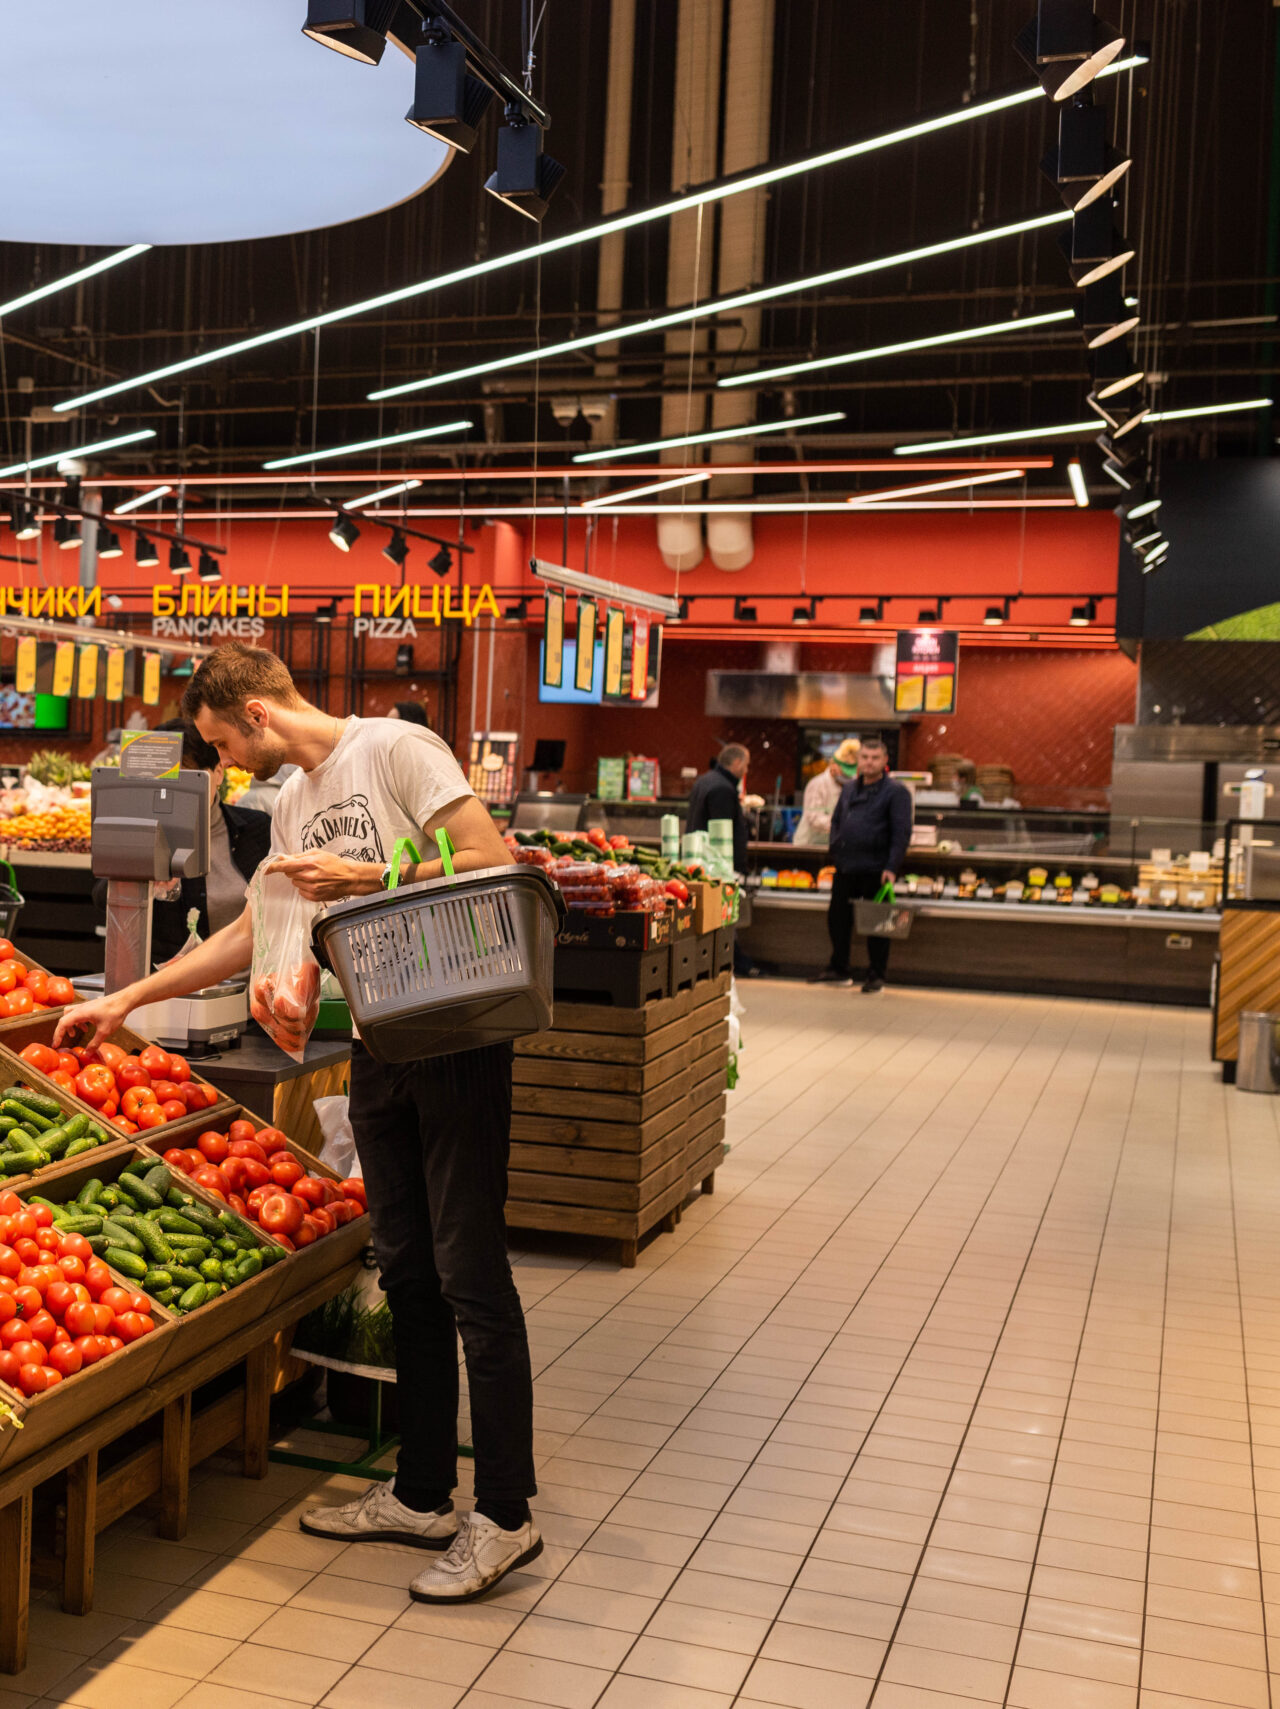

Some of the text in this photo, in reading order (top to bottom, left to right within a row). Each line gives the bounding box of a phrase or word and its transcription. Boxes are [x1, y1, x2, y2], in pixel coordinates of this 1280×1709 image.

[152, 584, 289, 617] БЛИНЫ
[354, 584, 501, 627] ПИЦЦА
[152, 617, 265, 637] PANCAKES
[354, 618, 417, 638] PIZZA
